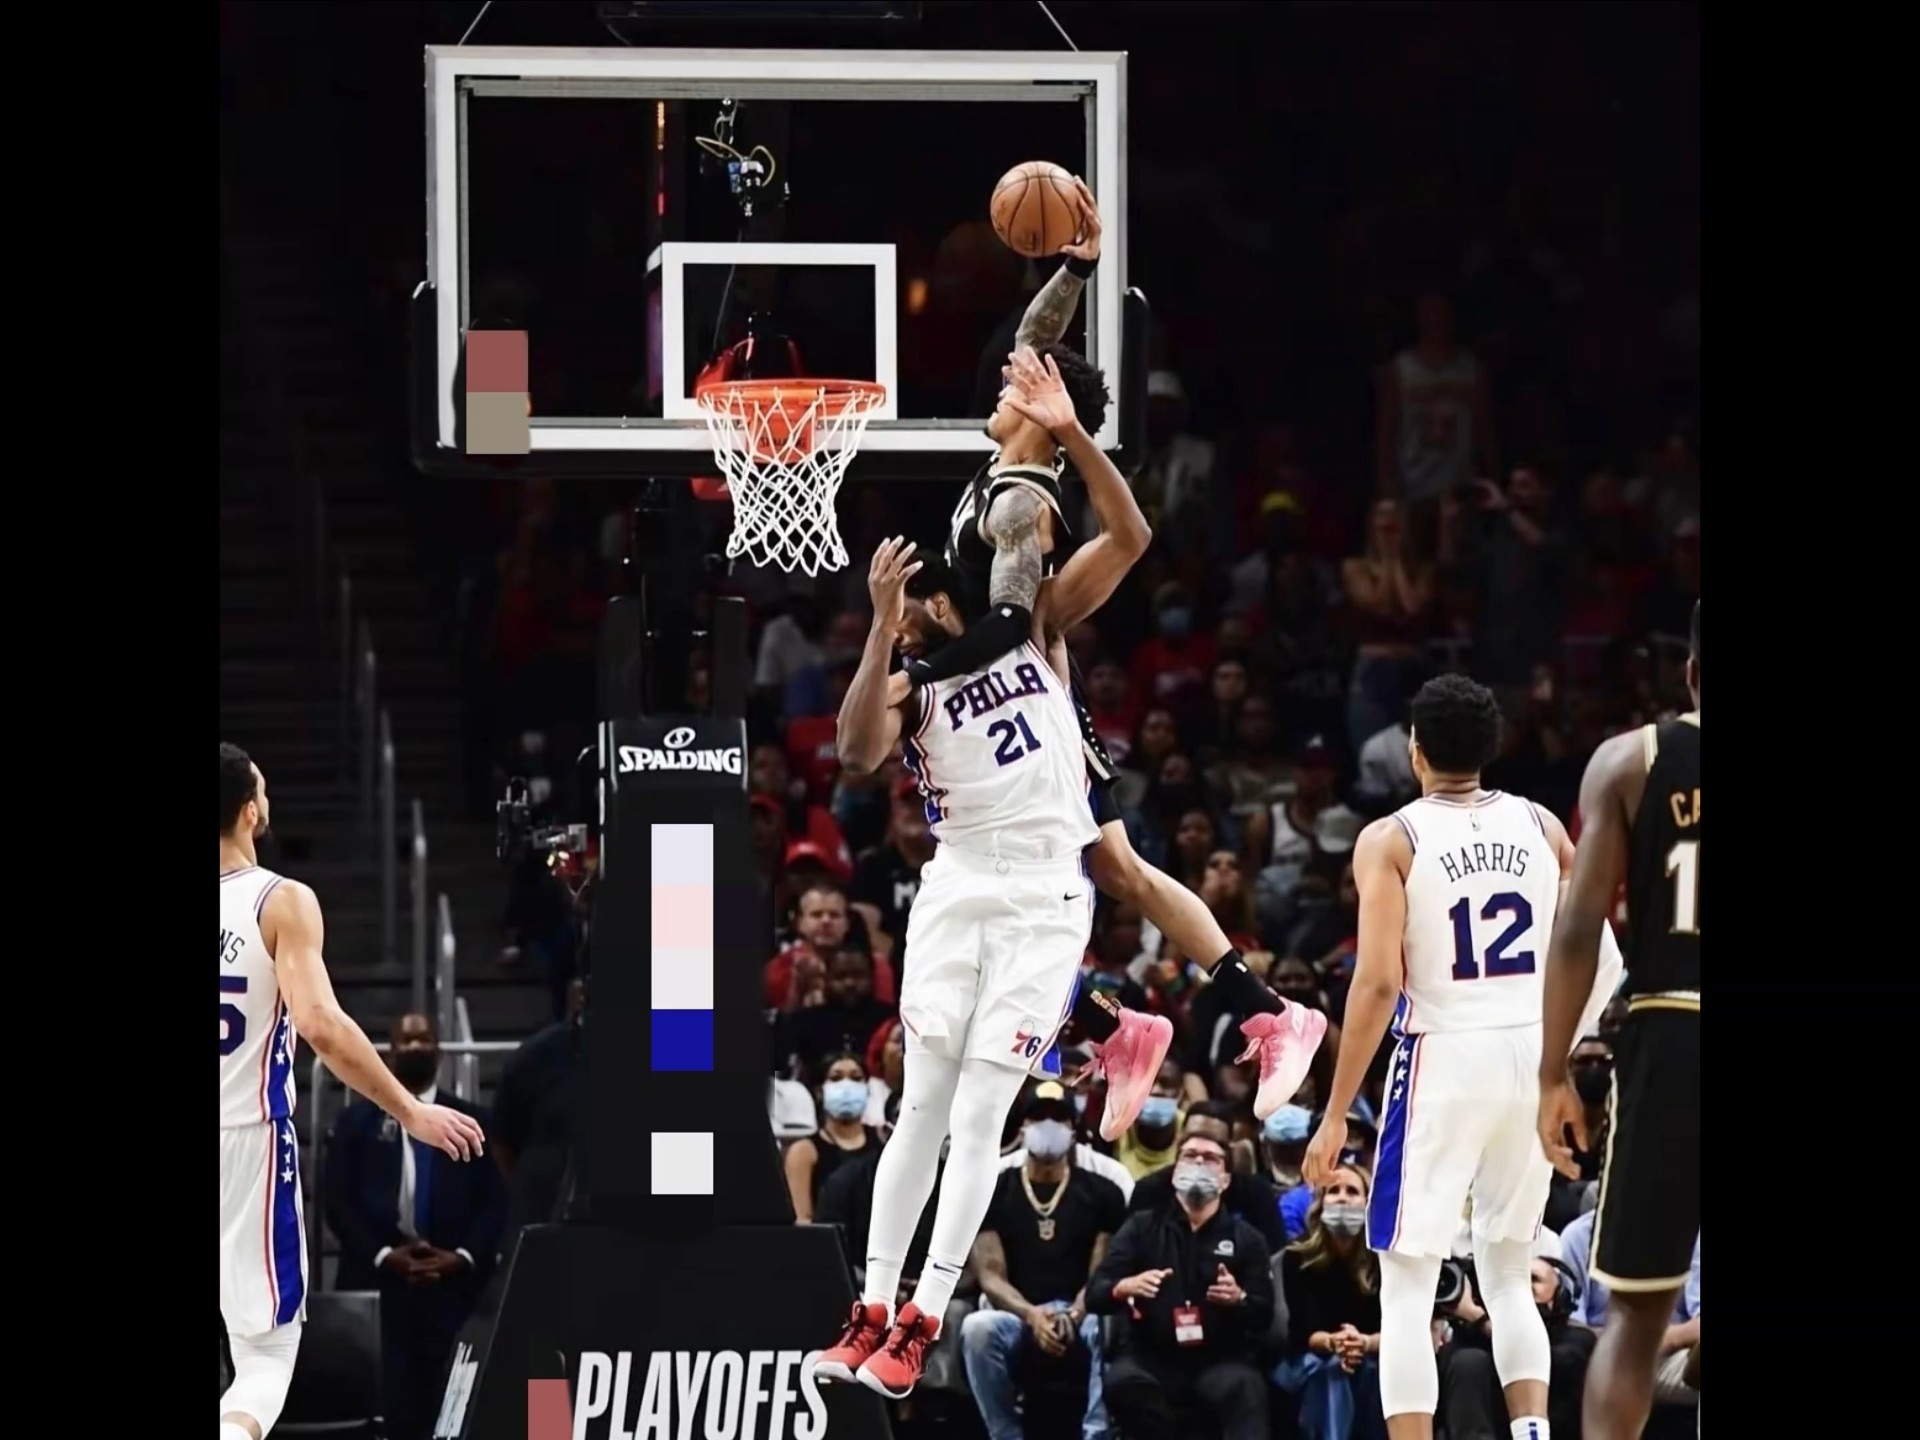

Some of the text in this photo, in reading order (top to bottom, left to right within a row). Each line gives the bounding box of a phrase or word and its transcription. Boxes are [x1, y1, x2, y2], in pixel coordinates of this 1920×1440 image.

[943, 662, 1049, 733] PHILA
[618, 745, 742, 775] SPALDING
[987, 711, 1042, 767] 21
[1439, 842, 1530, 883] HARRIS
[1448, 891, 1536, 981] 12
[571, 1350, 831, 1440] PLAYOFFS
